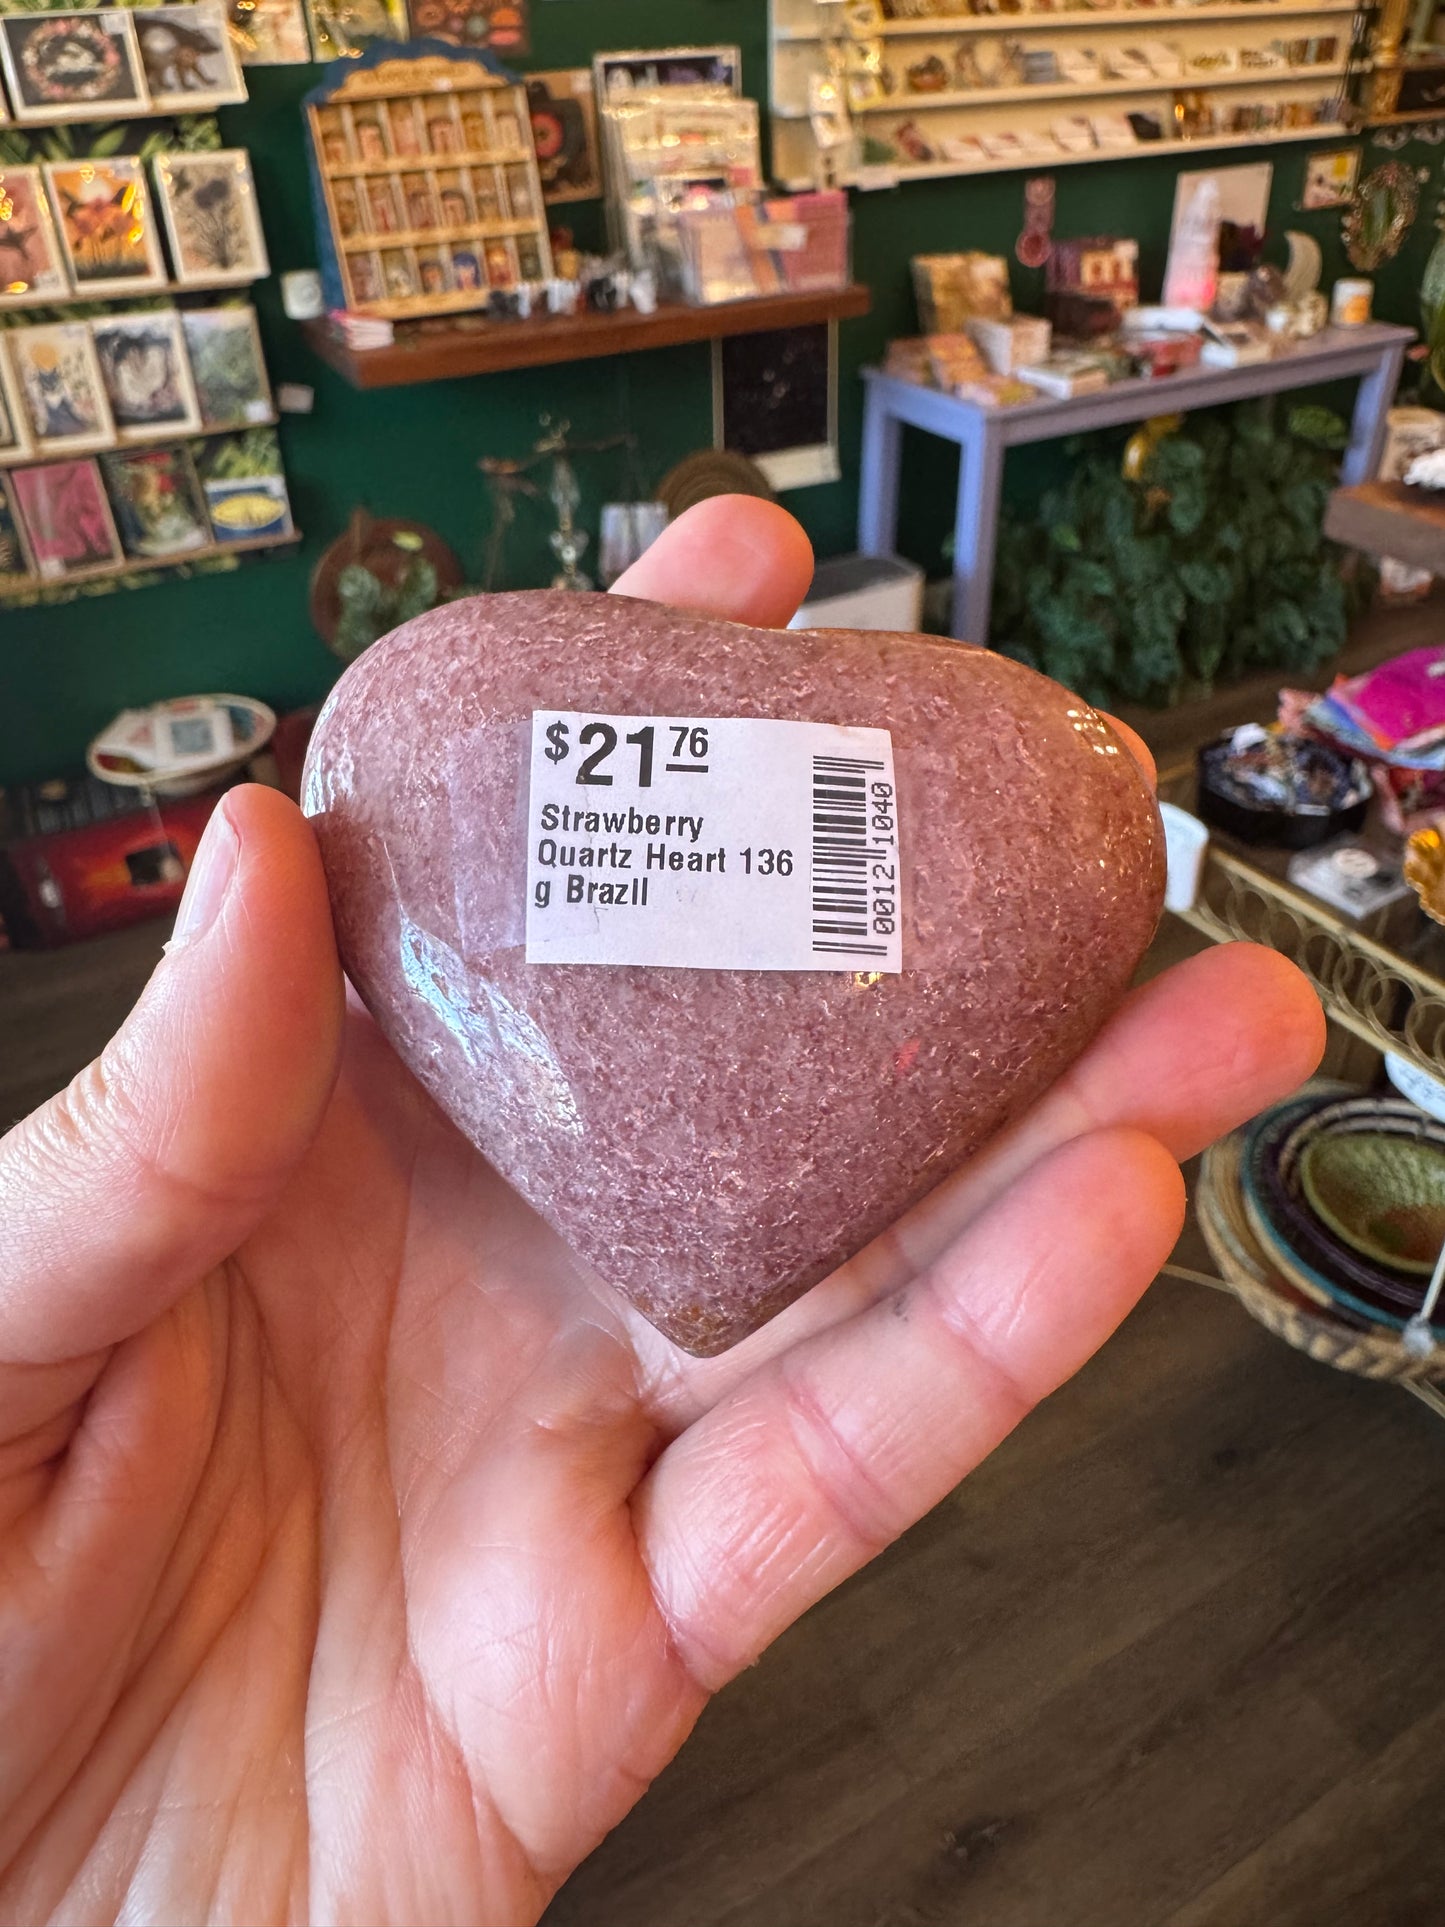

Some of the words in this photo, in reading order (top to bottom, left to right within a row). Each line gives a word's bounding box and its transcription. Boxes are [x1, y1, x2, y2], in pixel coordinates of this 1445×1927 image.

[540, 803, 704, 843] Strawberry
[538, 839, 632, 869] Quartz
[646, 843, 726, 873] Heart
[739, 847, 793, 876] 136
[535, 880, 551, 908] g
